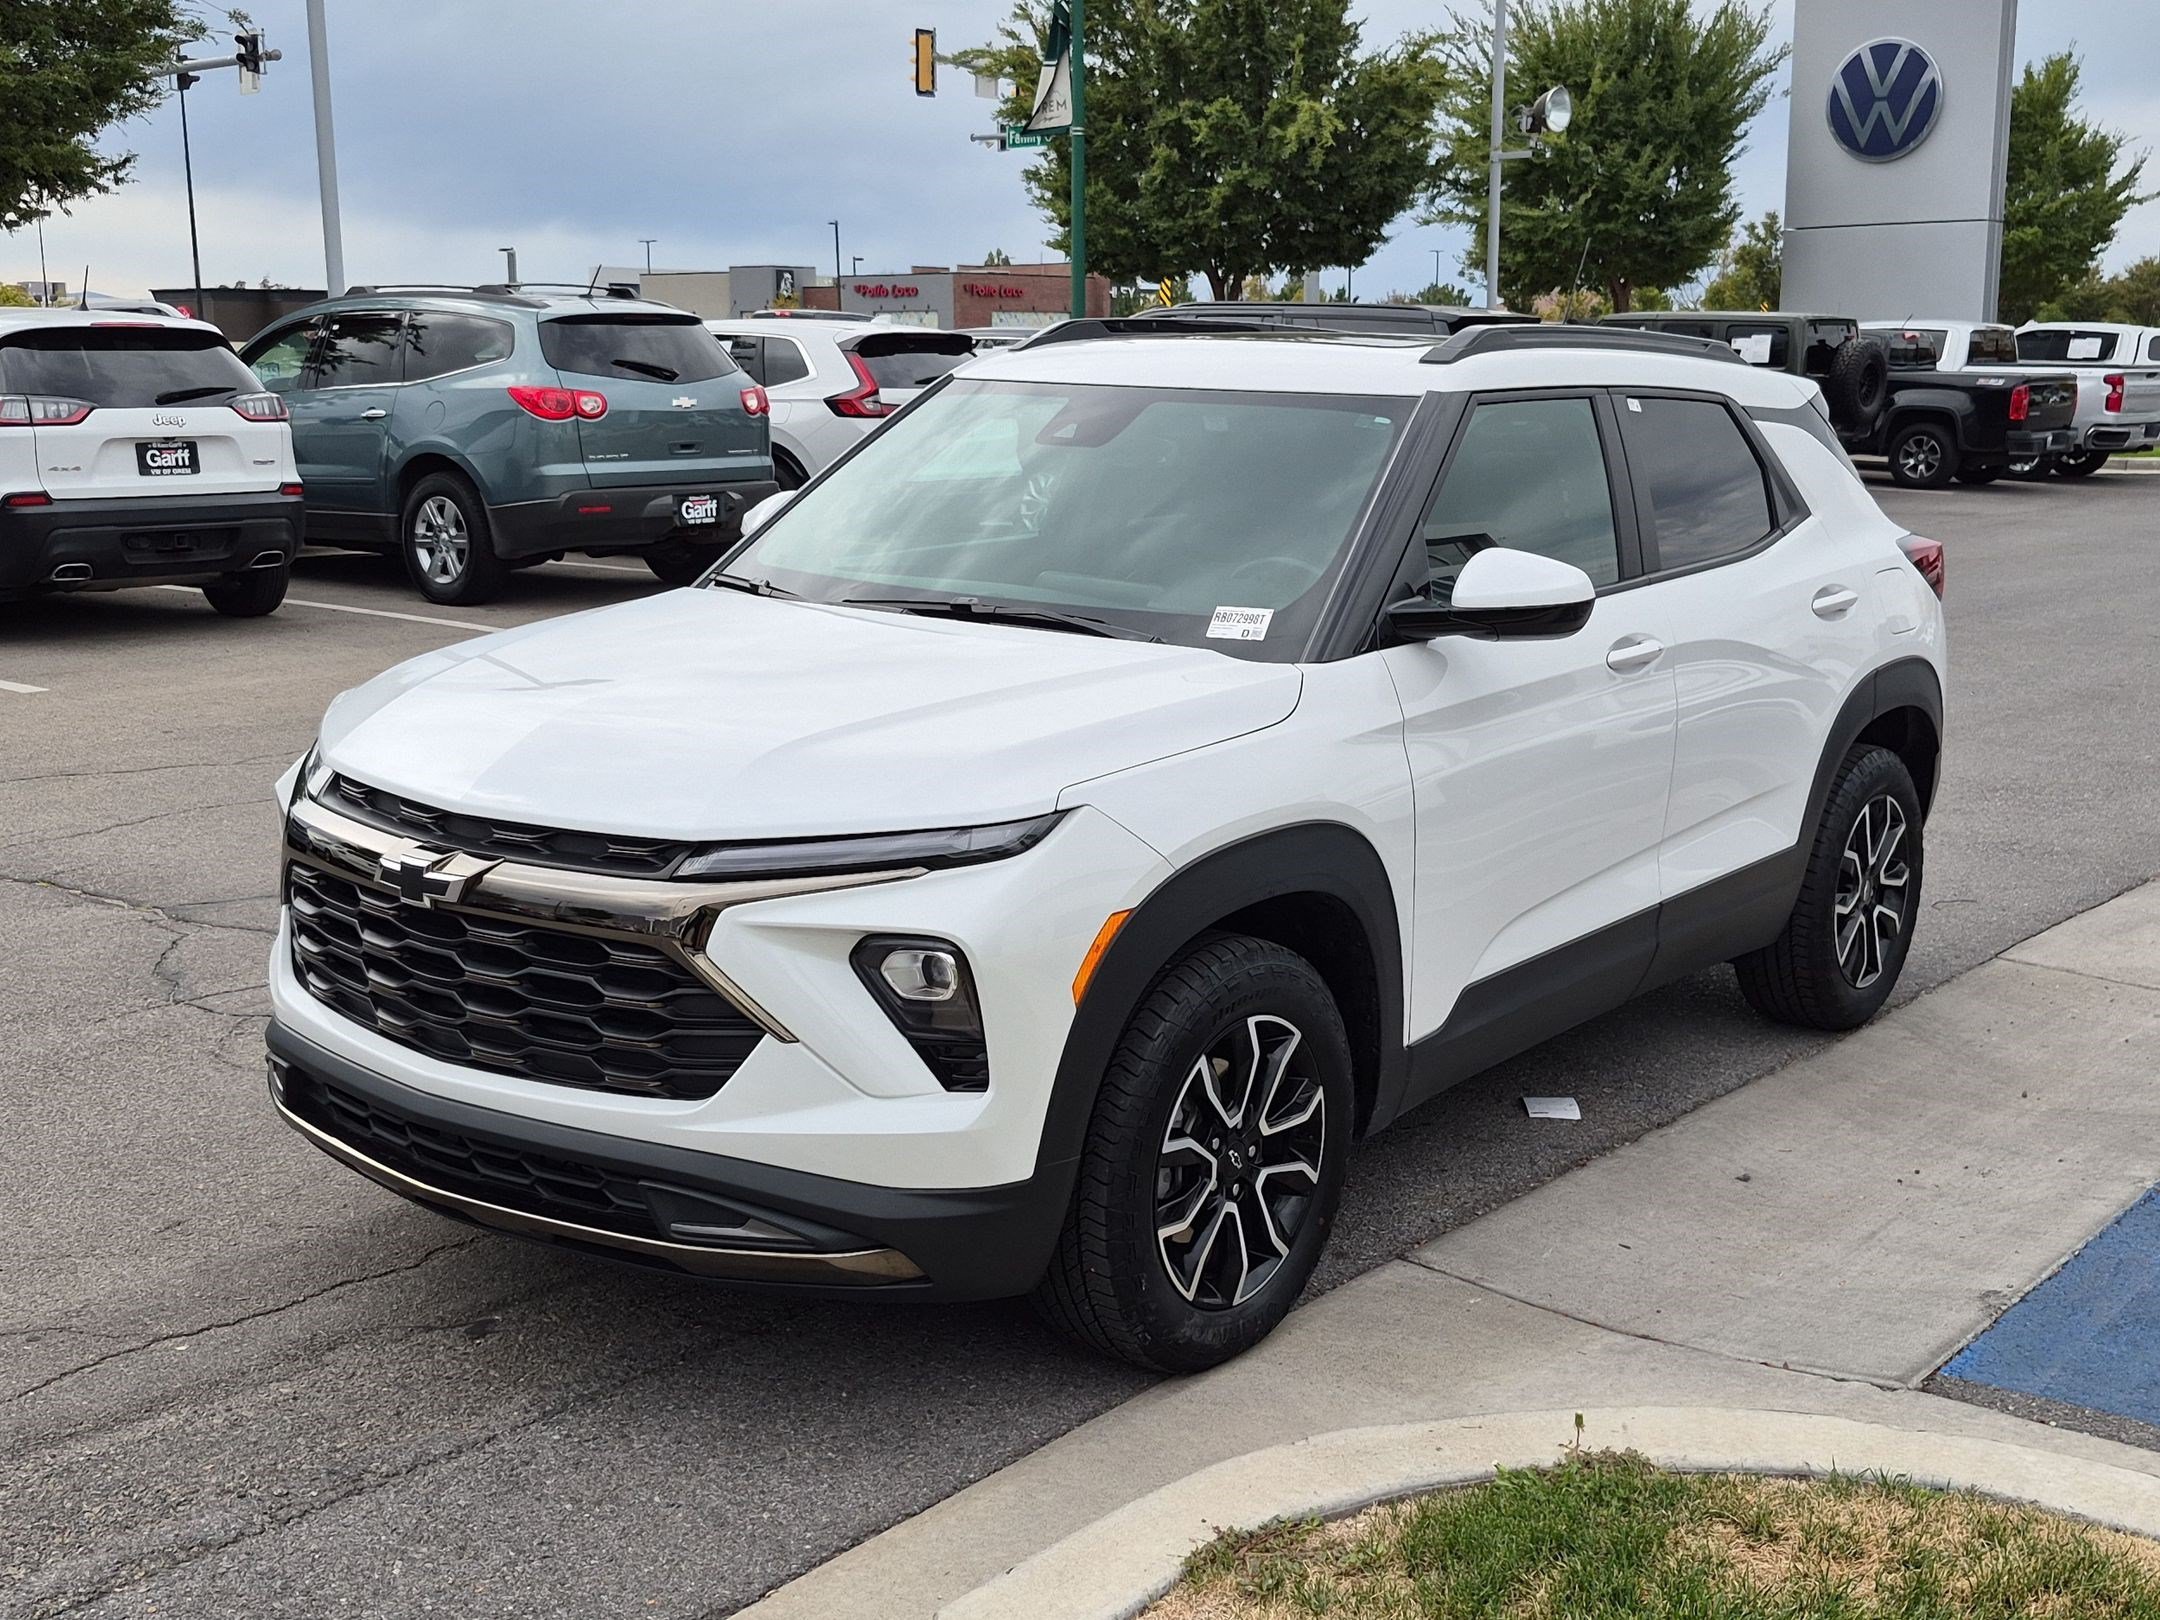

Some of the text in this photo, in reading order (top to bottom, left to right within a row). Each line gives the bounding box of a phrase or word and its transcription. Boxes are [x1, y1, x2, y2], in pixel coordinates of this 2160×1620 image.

[1041, 99, 1067, 114] REM
[152, 413, 186, 428] Jeep
[146, 448, 190, 468] Garff
[681, 499, 718, 519] Garff
